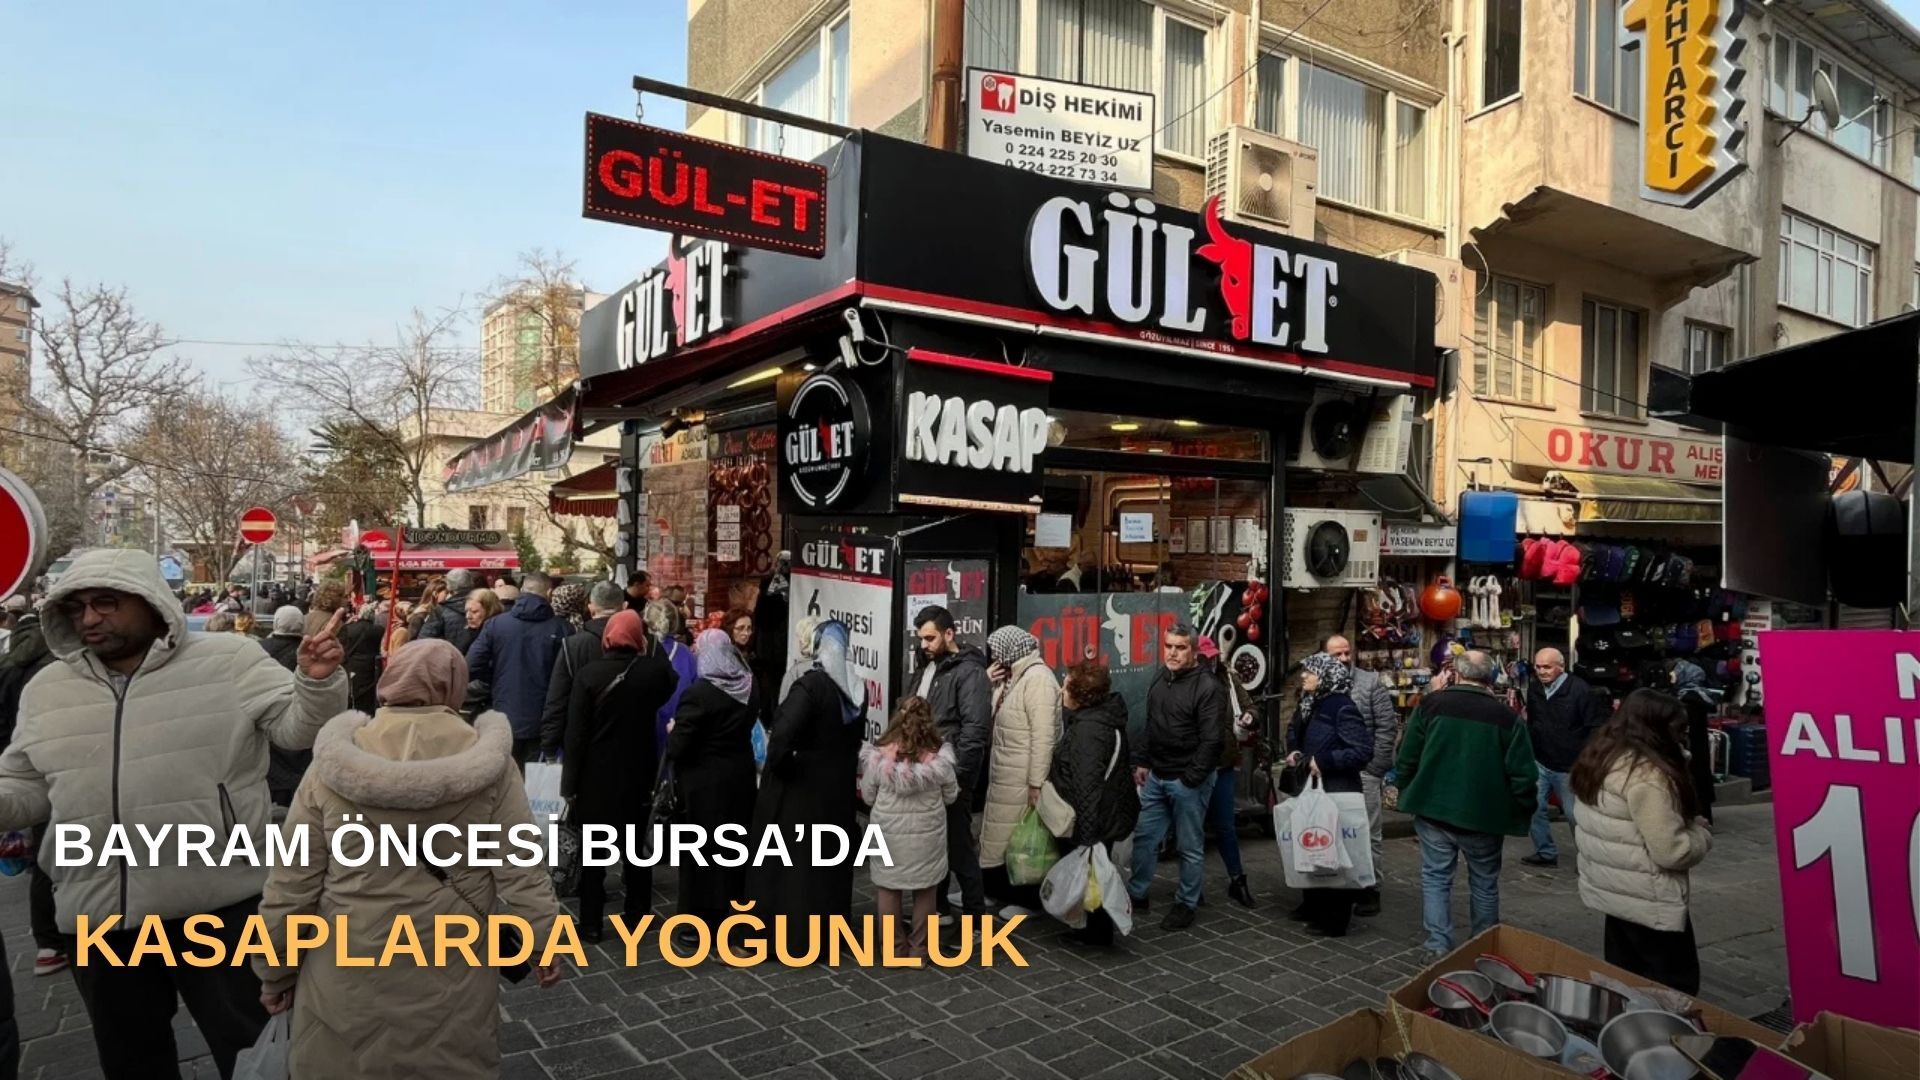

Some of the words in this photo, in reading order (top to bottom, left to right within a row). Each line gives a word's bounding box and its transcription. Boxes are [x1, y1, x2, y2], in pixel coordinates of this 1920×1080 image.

[1020, 88, 1056, 112] DİŞ
[1064, 95, 1143, 122] HEKİMİ
[982, 118, 1056, 141] Yasemin
[1061, 129, 1113, 148] BEYİZ
[1118, 137, 1141, 152] UZ
[1005, 142, 1014, 154] 0
[1018, 143, 1045, 157] 224
[1050, 148, 1075, 162] 225
[1080, 152, 1096, 164] 20
[1101, 155, 1118, 167] 30
[598, 148, 818, 232] GÜL-ET
[1049, 163, 1075, 178] 222
[1080, 167, 1096, 180] 73
[1101, 171, 1118, 183] 34
[1030, 191, 1207, 333] GÜL
[616, 267, 669, 370] GÜL
[785, 423, 822, 465] GÜL
[830, 421, 854, 459] ET
[906, 391, 1049, 474] KASAP
[1547, 428, 1675, 474] OKUR
[801, 539, 843, 570] GÜL
[854, 546, 885, 575] ET
